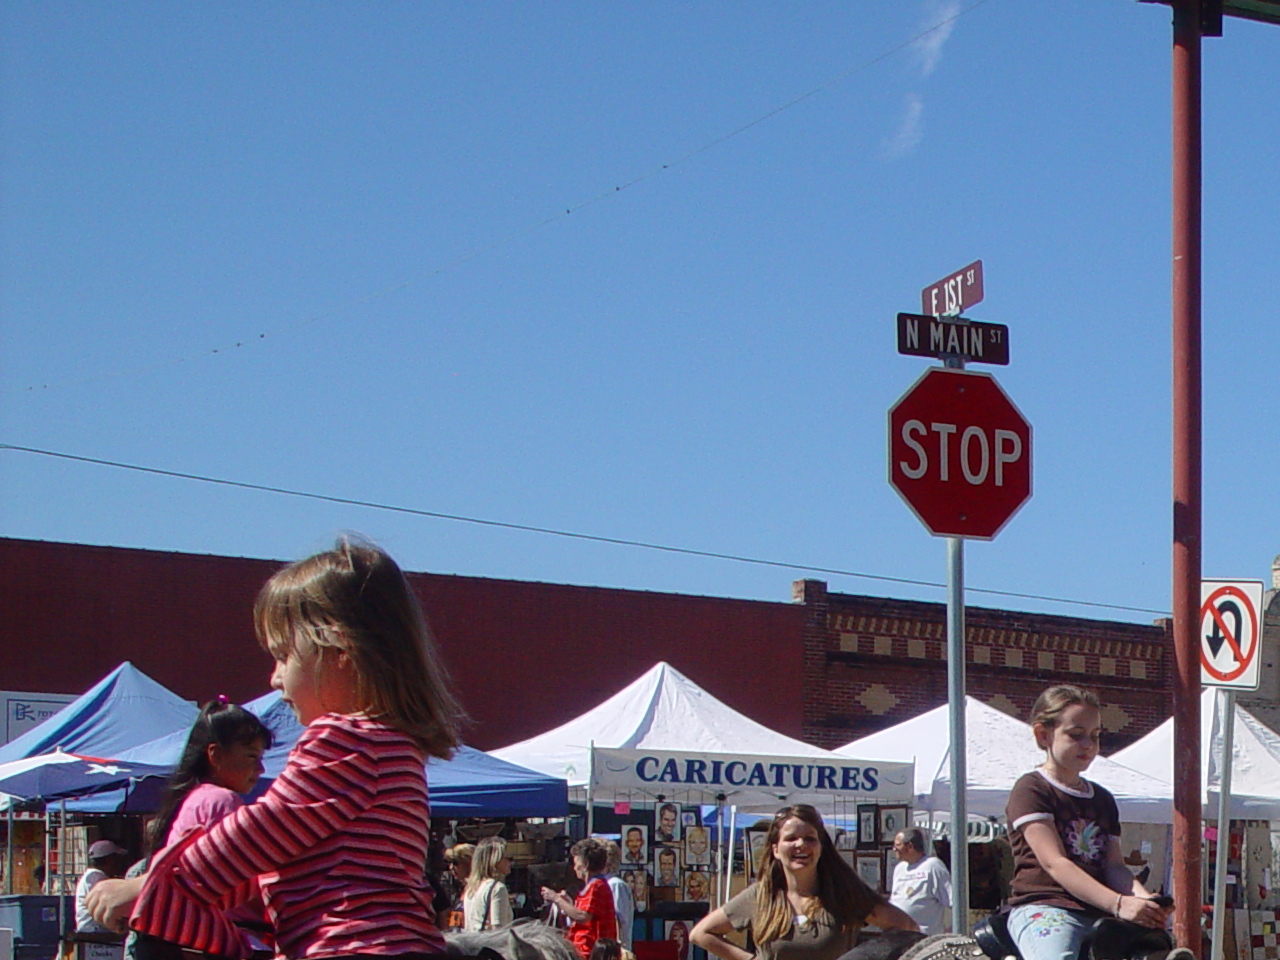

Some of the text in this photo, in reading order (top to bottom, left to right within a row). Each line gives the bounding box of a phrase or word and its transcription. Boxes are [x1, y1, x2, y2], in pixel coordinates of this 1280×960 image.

[931, 269, 975, 321] E 1ST ST
[906, 318, 1002, 357] N MAIN ST
[900, 419, 1023, 487] STOP
[635, 756, 879, 792] CARICATURES
